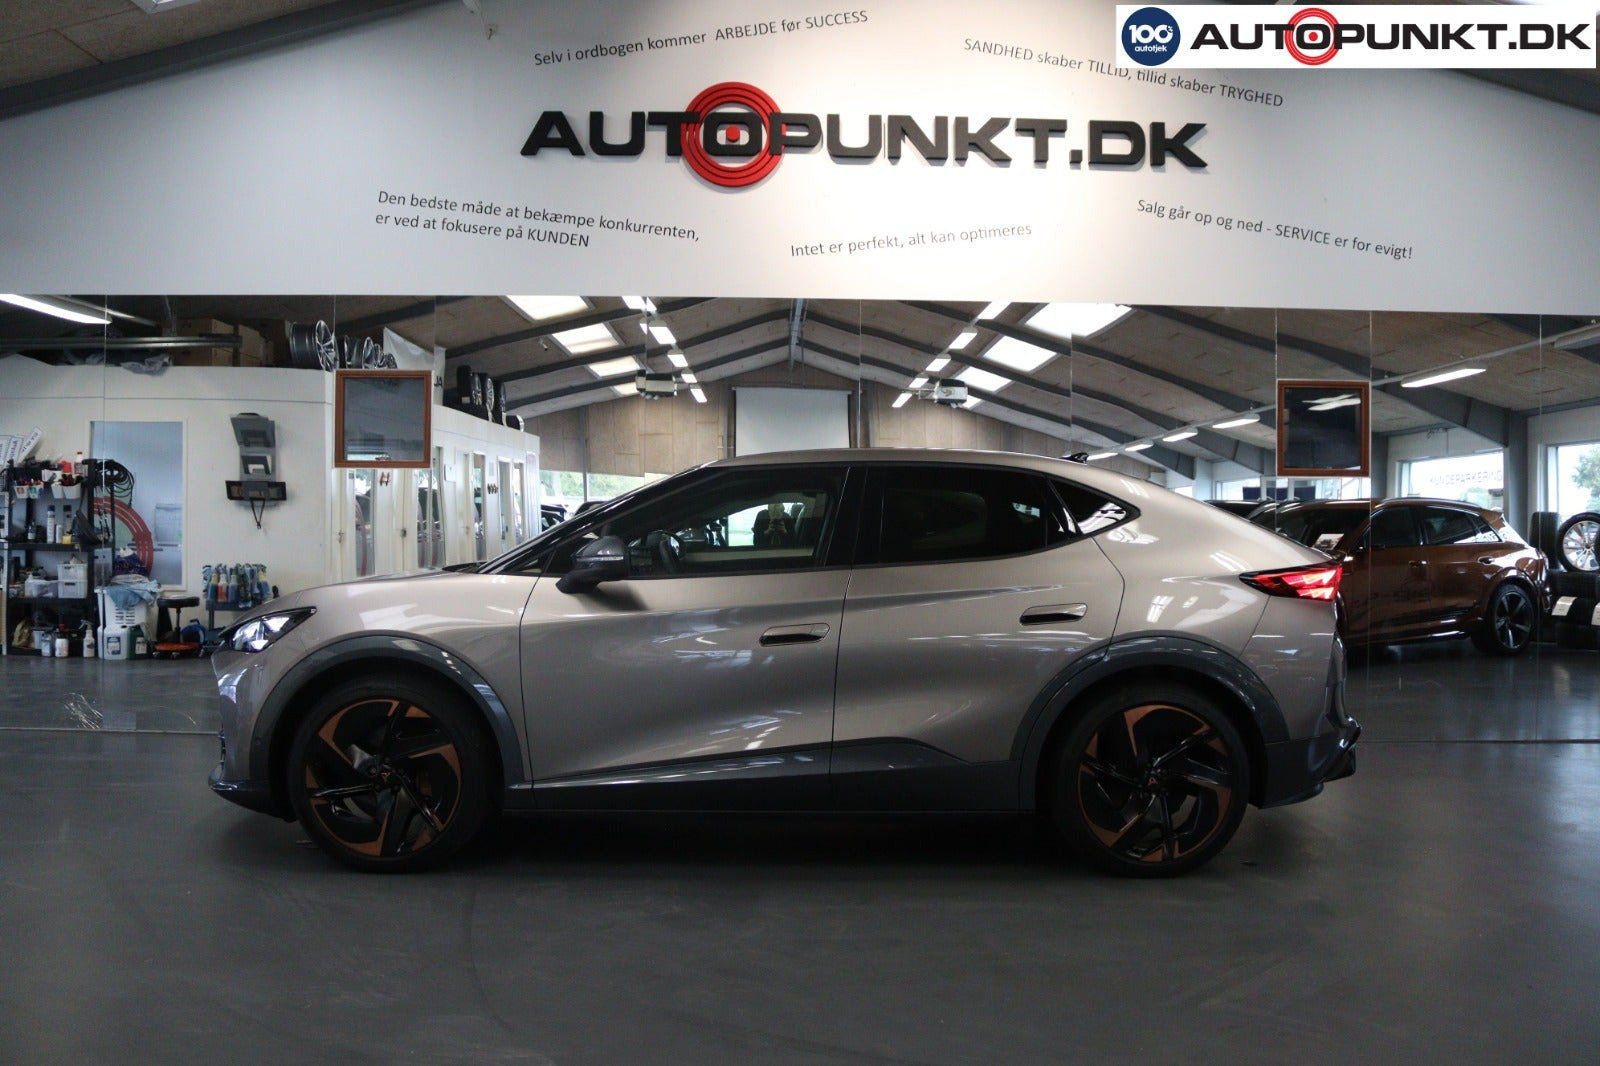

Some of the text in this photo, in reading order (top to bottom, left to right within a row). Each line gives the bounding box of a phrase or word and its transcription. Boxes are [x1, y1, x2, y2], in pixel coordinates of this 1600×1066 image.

[535, 10, 868, 65] Selv i ordbogen kommer ARBEJDE før SUCCESS
[965, 39, 1033, 60] SANDHED
[1038, 52, 1083, 69] skaber
[1137, 70, 1166, 84] tillid
[1170, 75, 1216, 94] skaber
[1220, 84, 1283, 106] TRYGHED
[520, 110, 1207, 169] AUTOPUNKT.DK
[376, 215, 589, 247] er ved at fokusere på KUNDEN
[379, 191, 700, 242] Den bedste måde at bekæmpe konkurrenten,
[791, 226, 1032, 256] Intet er perfekt, alt kan optimeres
[1138, 200, 1165, 218] Salg
[1169, 206, 1191, 220] går
[1195, 213, 1212, 226] op
[1217, 217, 1233, 230] og
[1237, 220, 1263, 232] ned
[1275, 224, 1330, 244] SERVICE
[1335, 237, 1348, 247] er
[1353, 237, 1371, 251] for
[1375, 244, 1412, 260] evigt!
